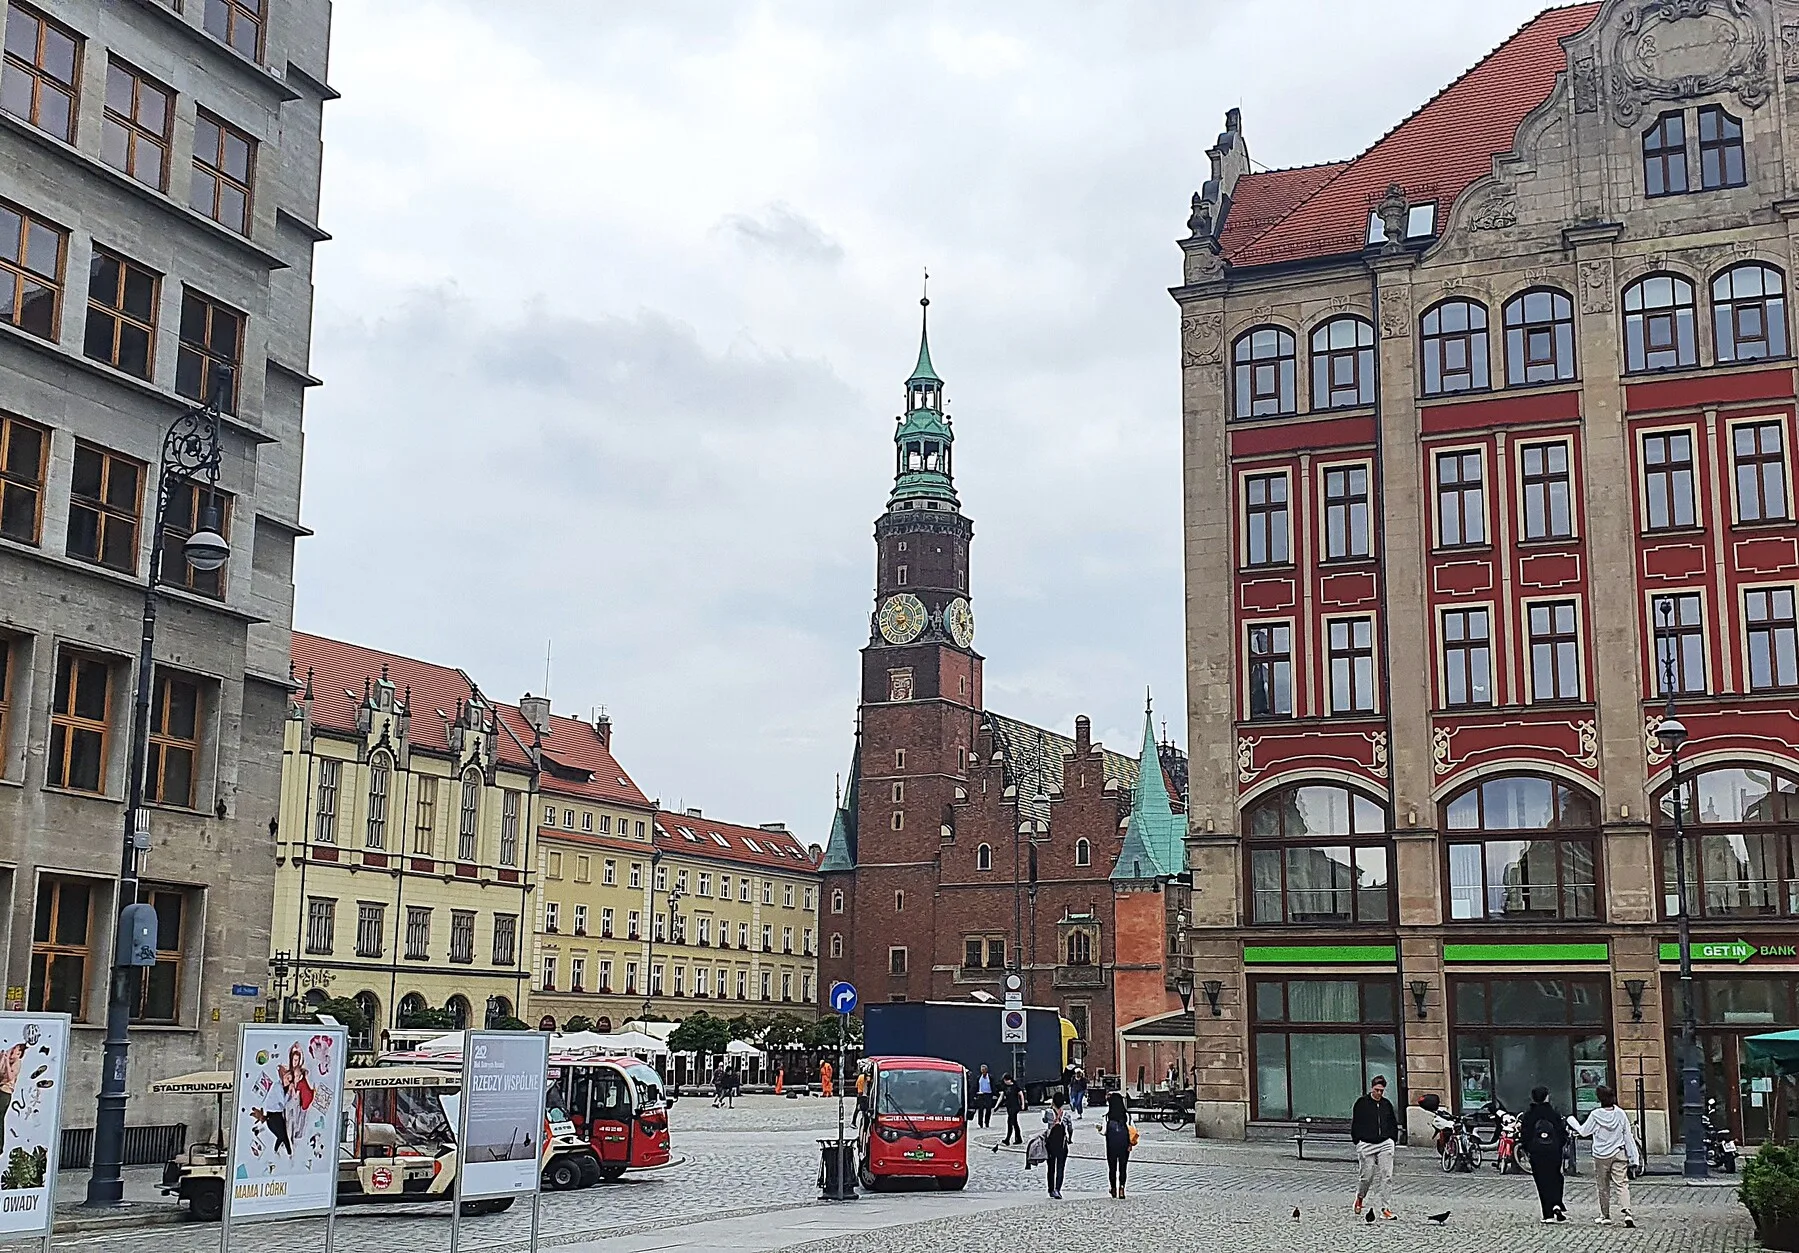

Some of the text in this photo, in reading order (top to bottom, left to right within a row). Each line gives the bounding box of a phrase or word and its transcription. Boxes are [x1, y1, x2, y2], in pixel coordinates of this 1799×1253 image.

[1760, 945, 1797, 956] BANK
[354, 1076, 421, 1087] ZWIEDZANIE
[472, 1071, 539, 1092] RZECZY WSPÓLNE
[234, 1183, 259, 1199] MAMA
[260, 1183, 264, 1197] I
[264, 1179, 288, 1197] CÓRKI
[3, 1194, 40, 1213] OWADY
